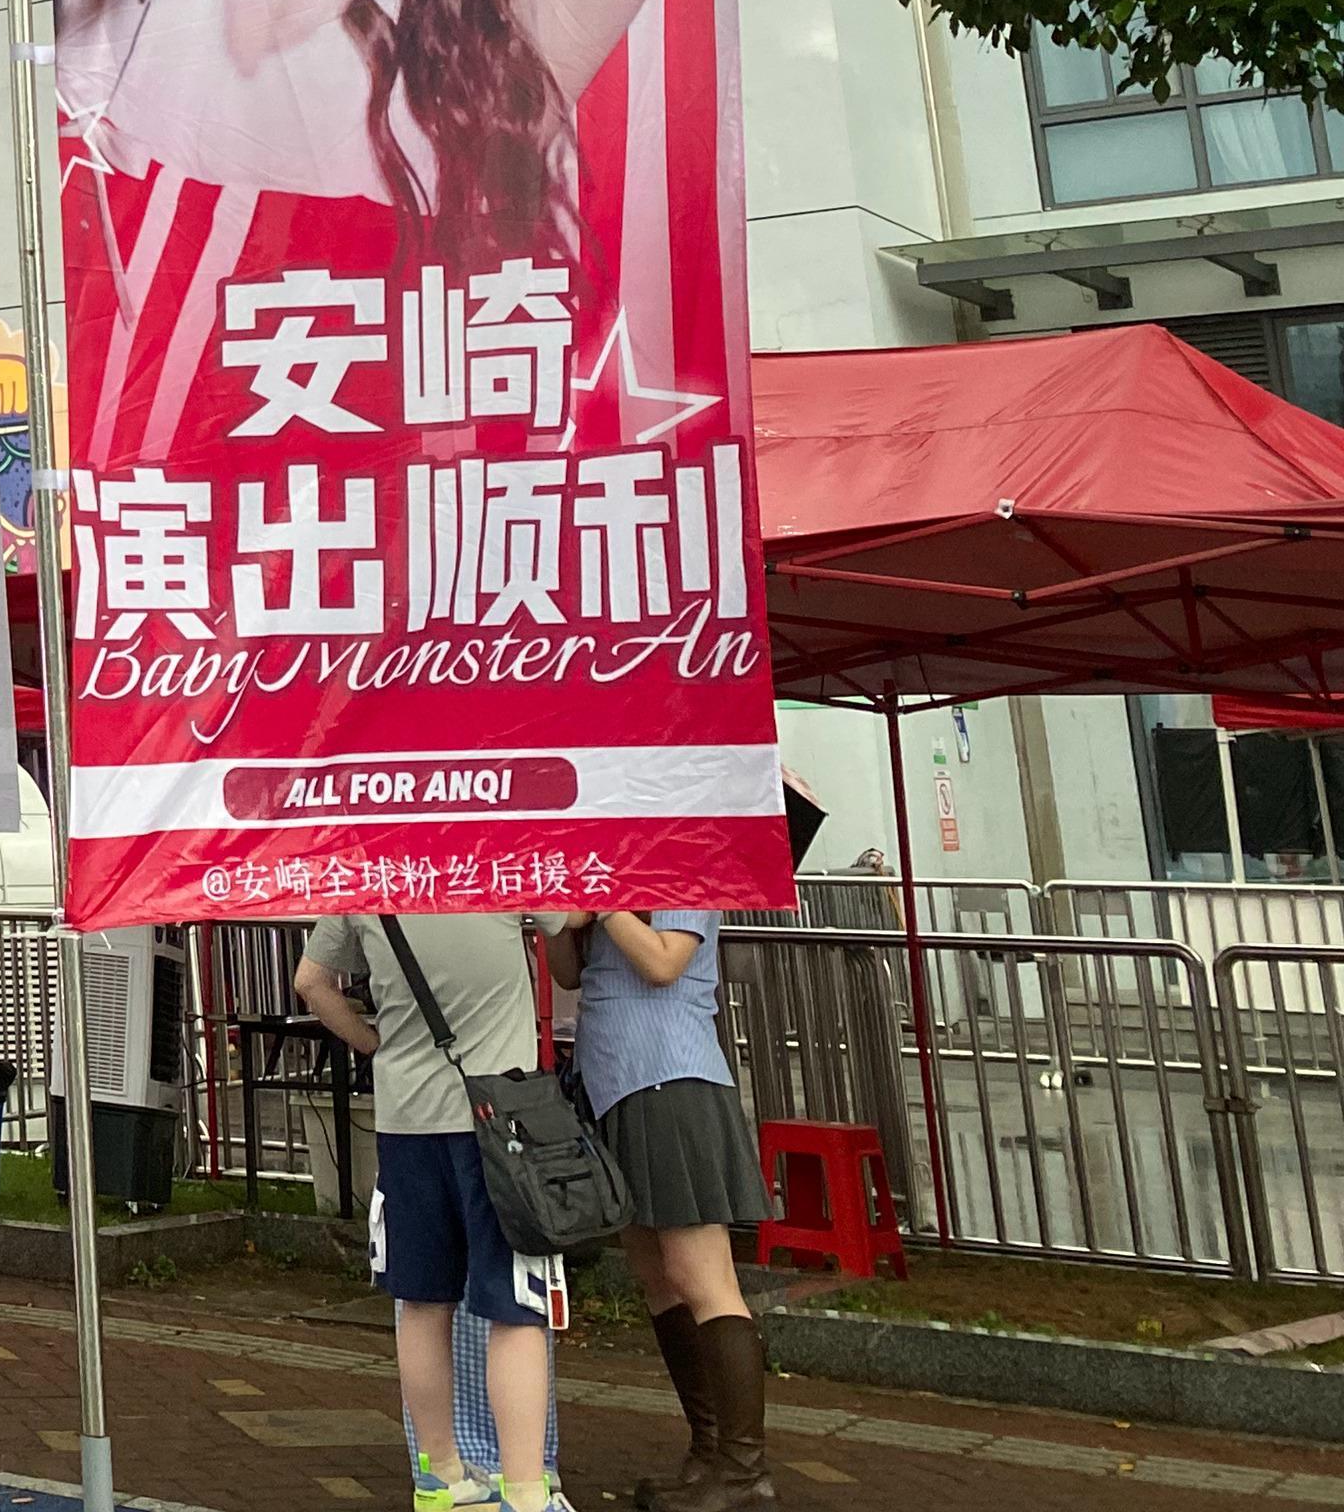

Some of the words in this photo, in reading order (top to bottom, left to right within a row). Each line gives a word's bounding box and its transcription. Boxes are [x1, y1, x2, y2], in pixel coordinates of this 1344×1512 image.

[220, 257, 573, 437] 安崎
[72, 444, 748, 641] 演出顺利
[78, 636, 264, 744] Baby
[255, 623, 600, 692] Monster
[592, 599, 760, 684] An
[284, 776, 341, 809] ALL
[349, 772, 415, 805] FOR
[422, 768, 513, 804] ANQI
[202, 850, 616, 902] @安崎全球粉丝后援会
